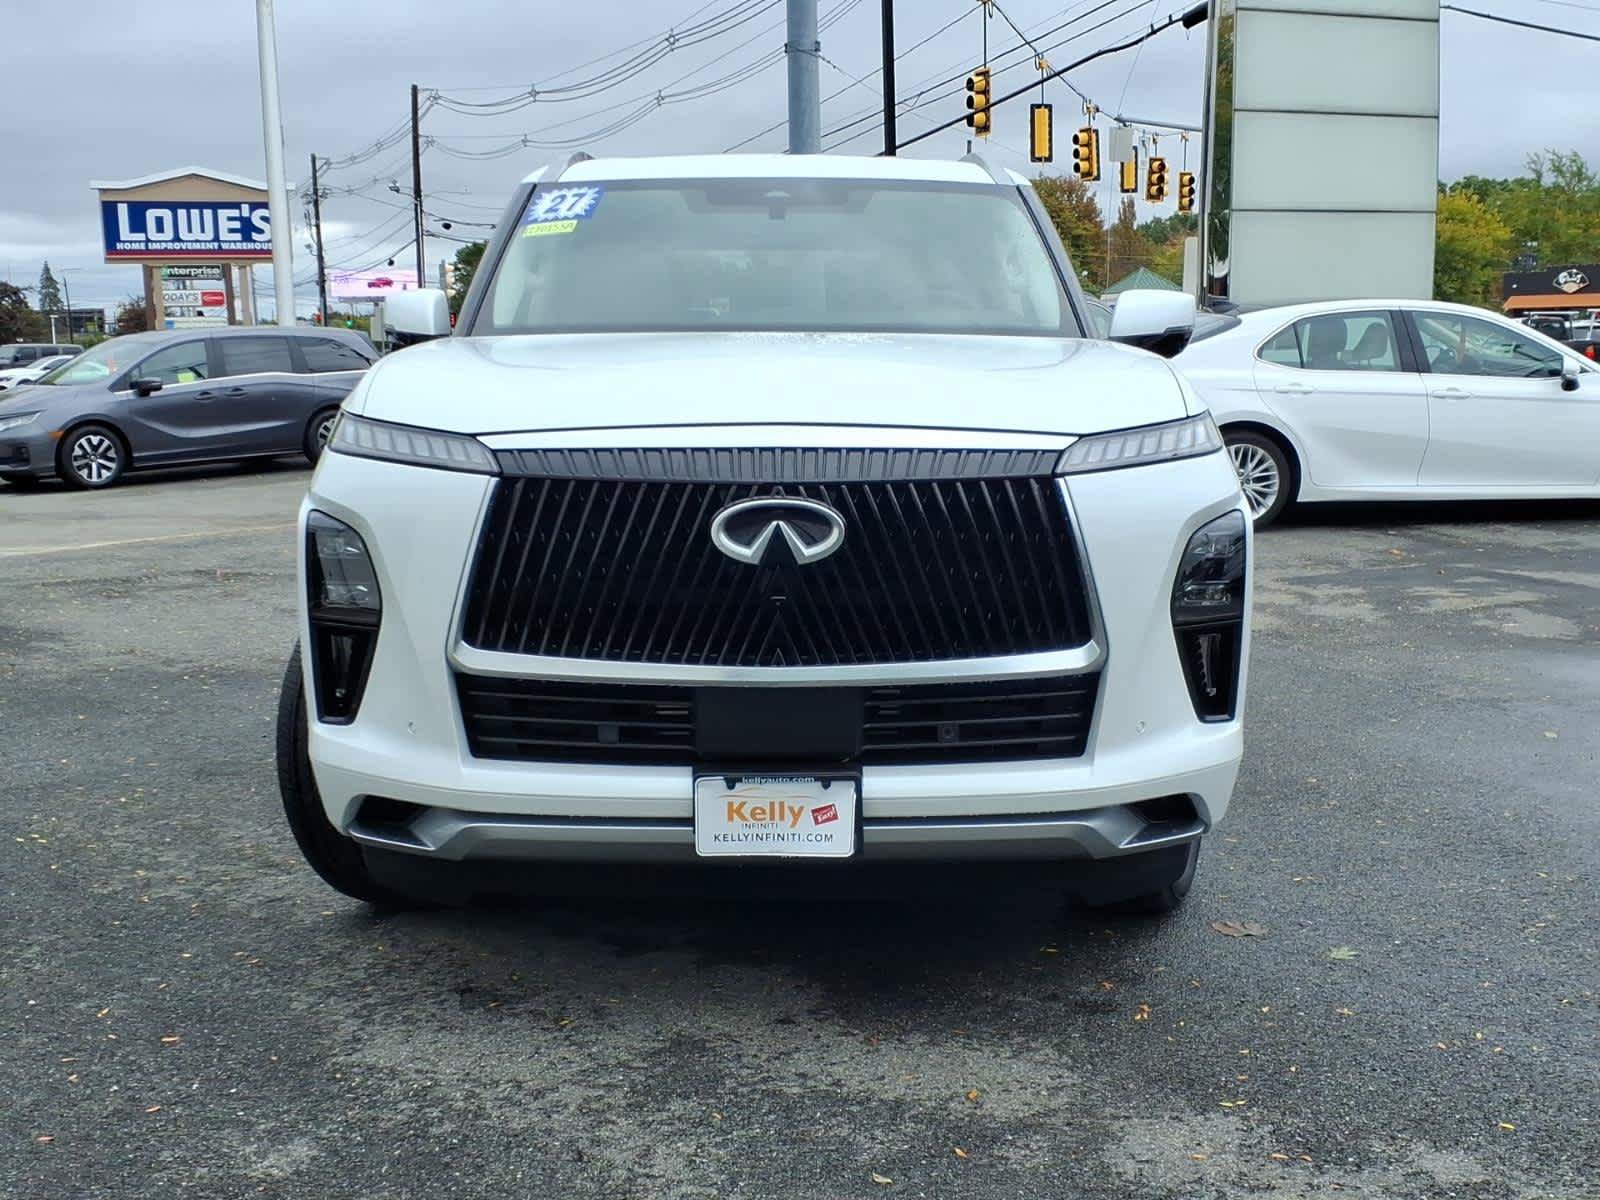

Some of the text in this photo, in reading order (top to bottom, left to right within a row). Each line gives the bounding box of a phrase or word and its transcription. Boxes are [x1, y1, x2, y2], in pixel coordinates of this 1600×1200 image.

[117, 203, 272, 242] LOWE'S
[116, 241, 273, 250] HOME IMPROVEMENT WAREHOUS
[742, 776, 815, 785] kellyauto.com
[726, 801, 805, 828] Kelly
[713, 833, 833, 843] KELLYINFINITI.COM
